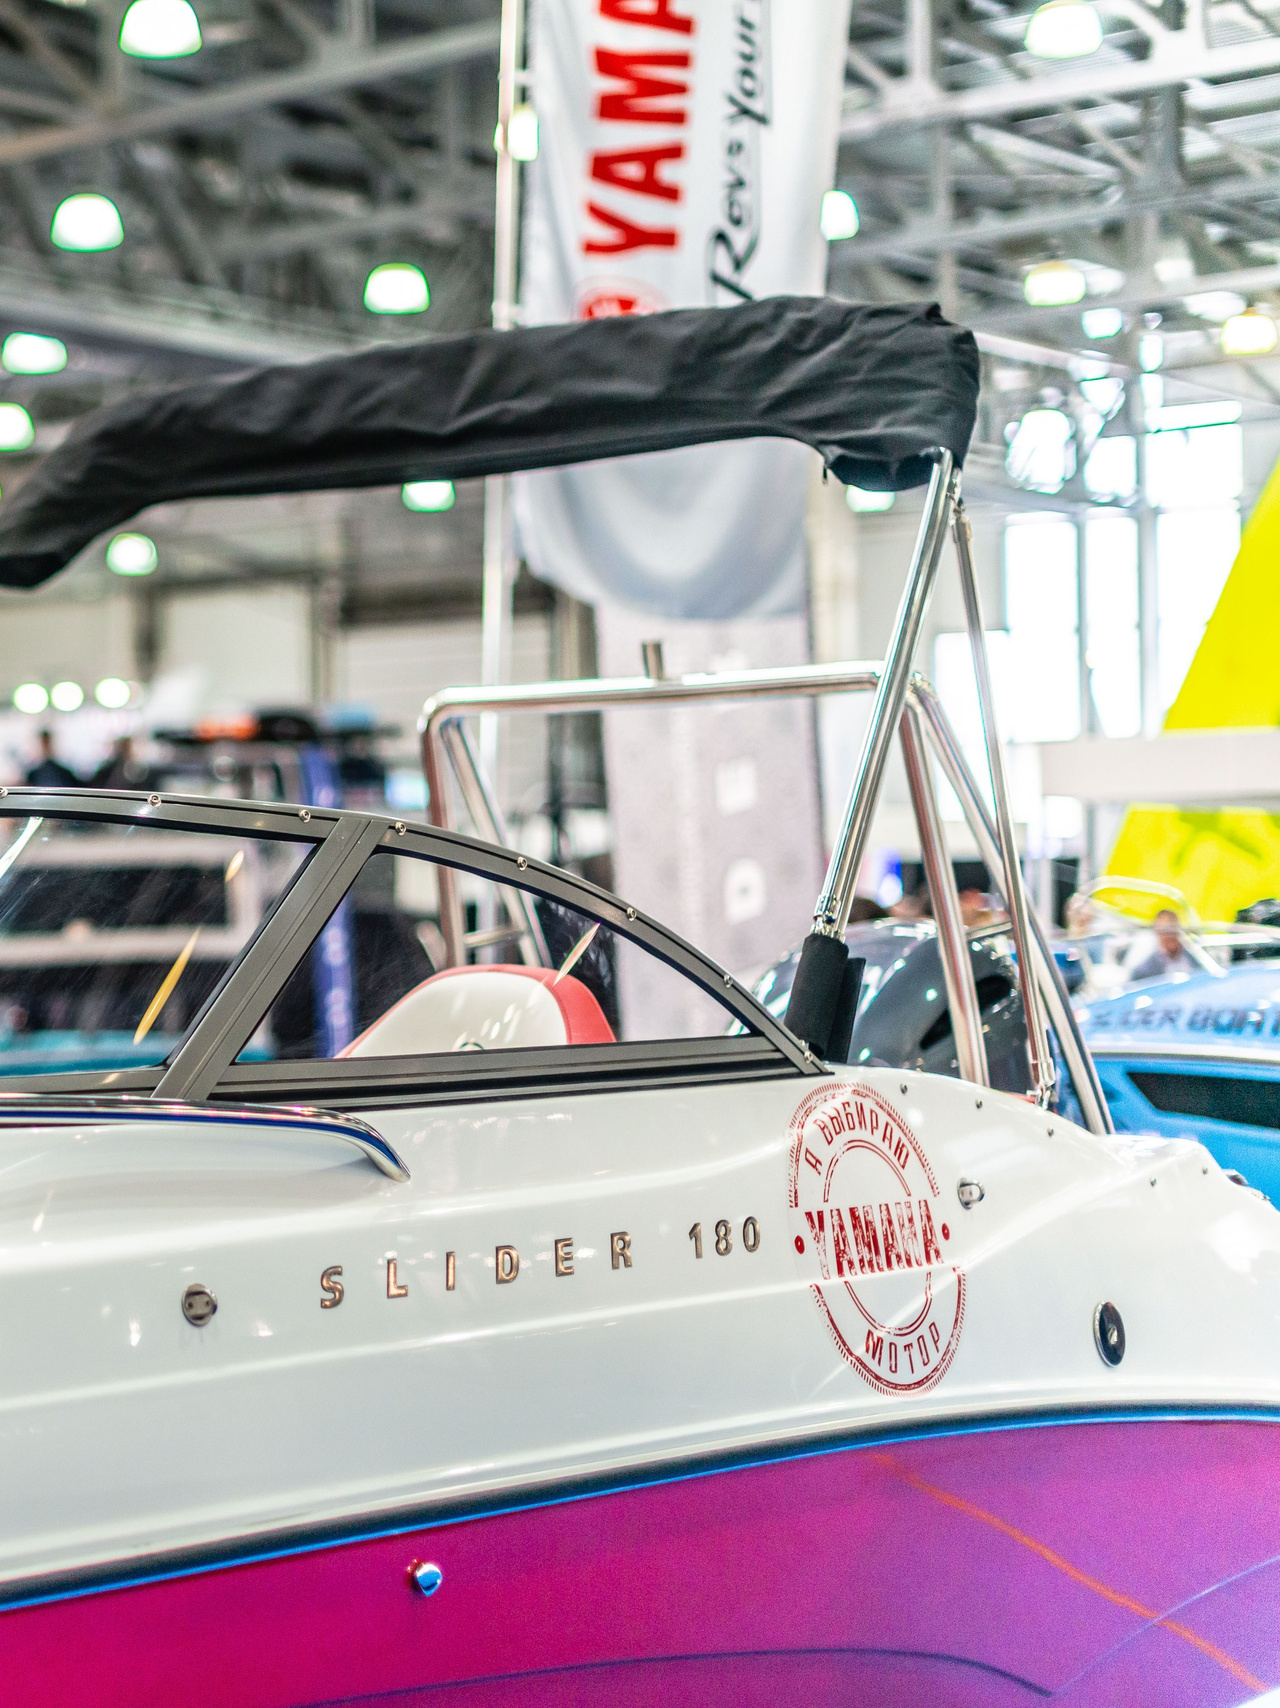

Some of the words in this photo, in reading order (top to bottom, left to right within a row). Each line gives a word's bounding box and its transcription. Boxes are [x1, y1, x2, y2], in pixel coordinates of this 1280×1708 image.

[708, 139, 760, 301] Revs
[813, 1100, 910, 1170] ВЫБИРАЮ
[320, 1231, 633, 1309] SLIDER
[688, 1215, 761, 1260] 180
[804, 1199, 945, 1280] YAMAHA
